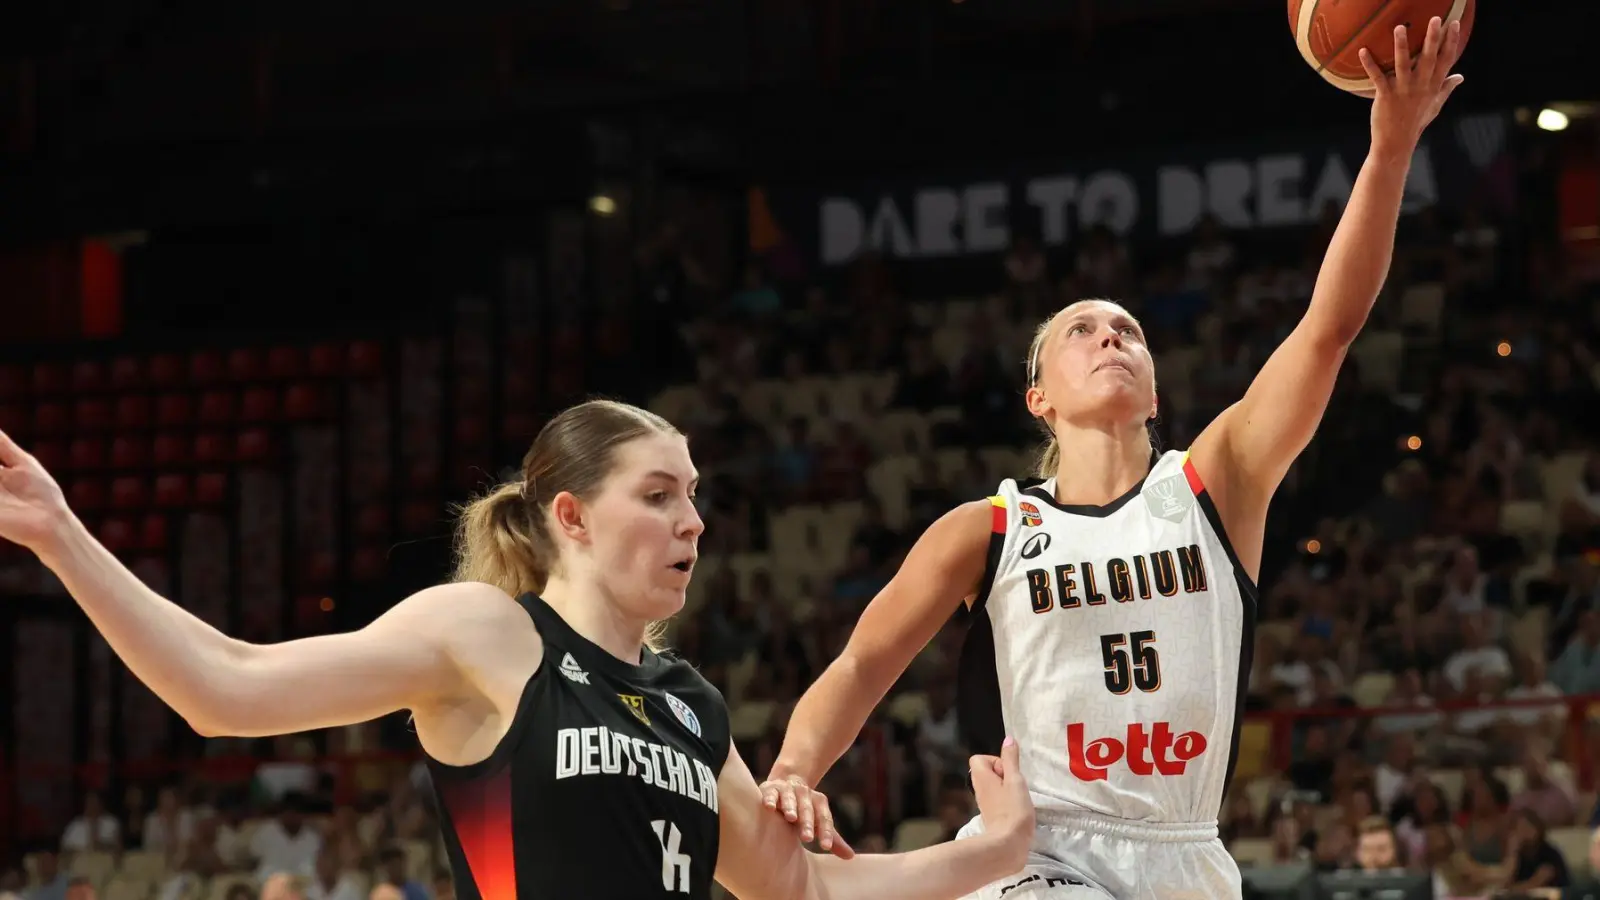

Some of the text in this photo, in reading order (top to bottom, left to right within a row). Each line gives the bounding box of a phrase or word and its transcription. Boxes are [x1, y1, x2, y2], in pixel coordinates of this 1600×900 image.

[821, 184, 1009, 264] DARE
[1026, 169, 1138, 244] TO
[1027, 544, 1207, 614] BELGIUM
[1100, 630, 1161, 694] 55
